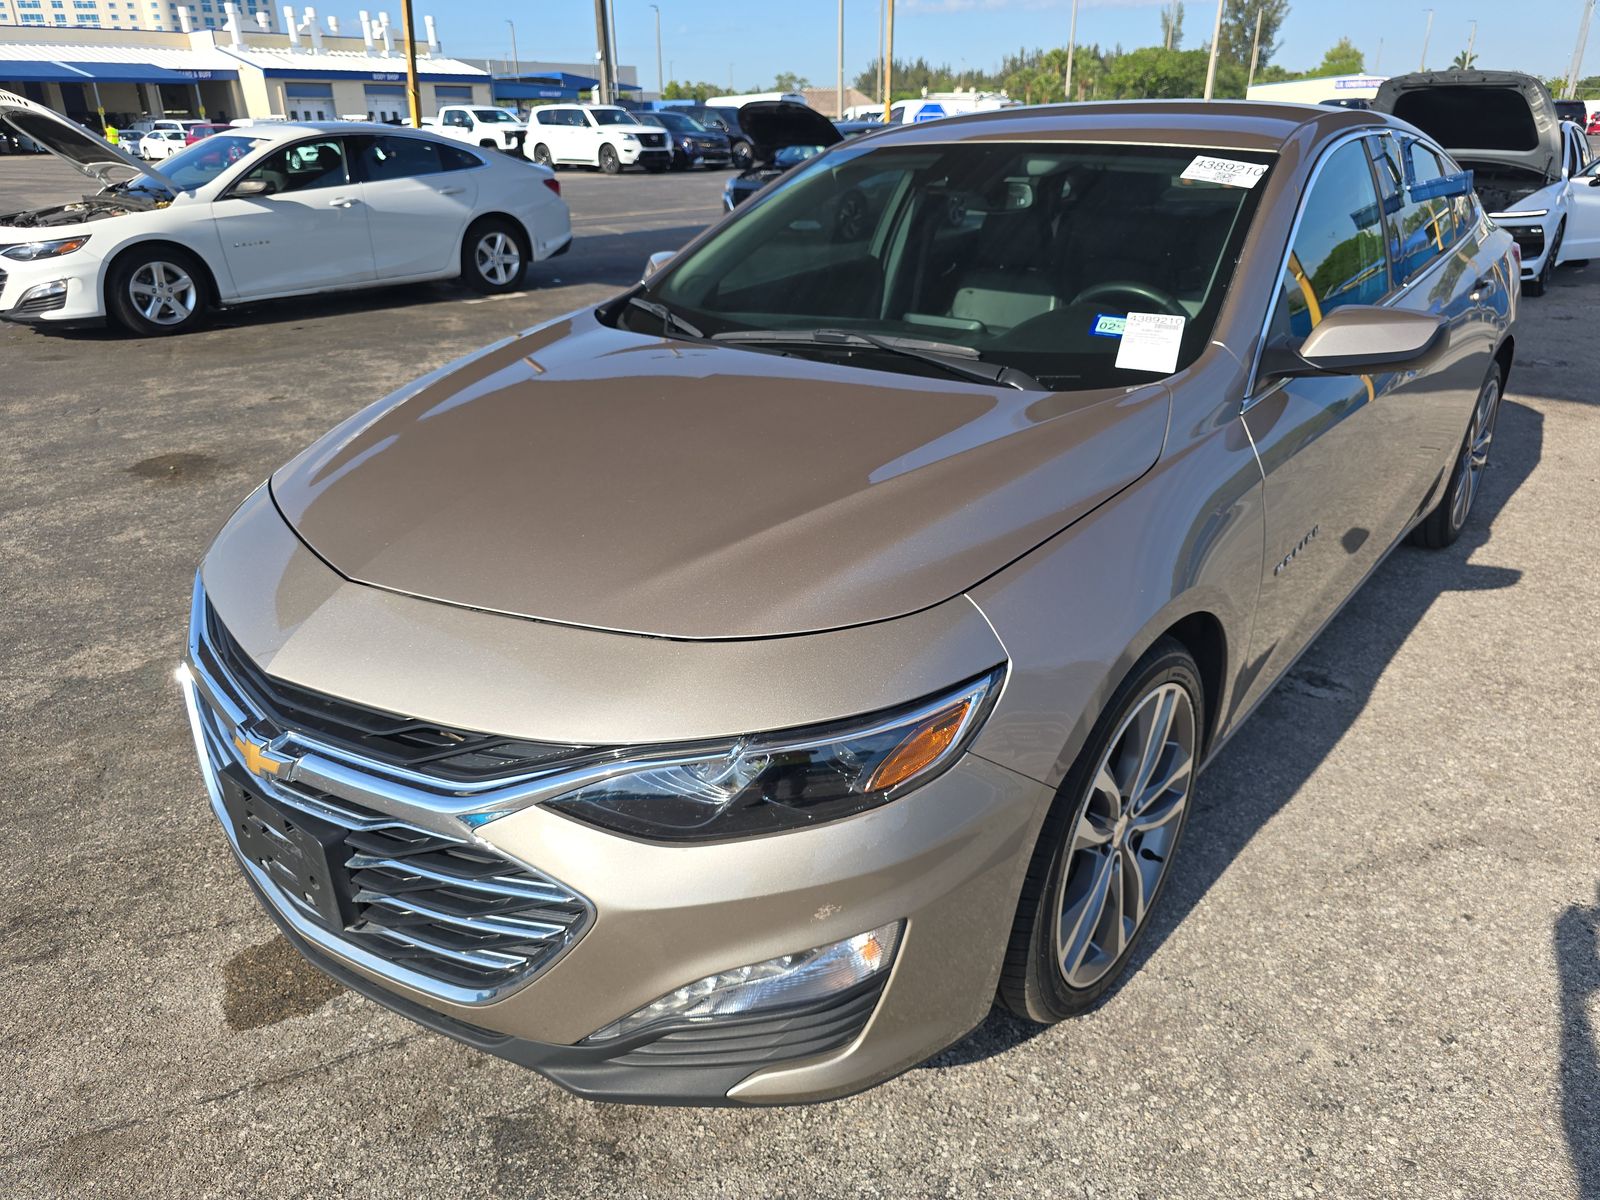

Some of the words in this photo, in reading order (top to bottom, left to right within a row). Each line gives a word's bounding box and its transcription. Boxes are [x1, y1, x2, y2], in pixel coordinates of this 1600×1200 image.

[386, 73, 400, 81] SHOP
[1195, 159, 1265, 176] 4389210
[1130, 315, 1183, 325] 4389210
